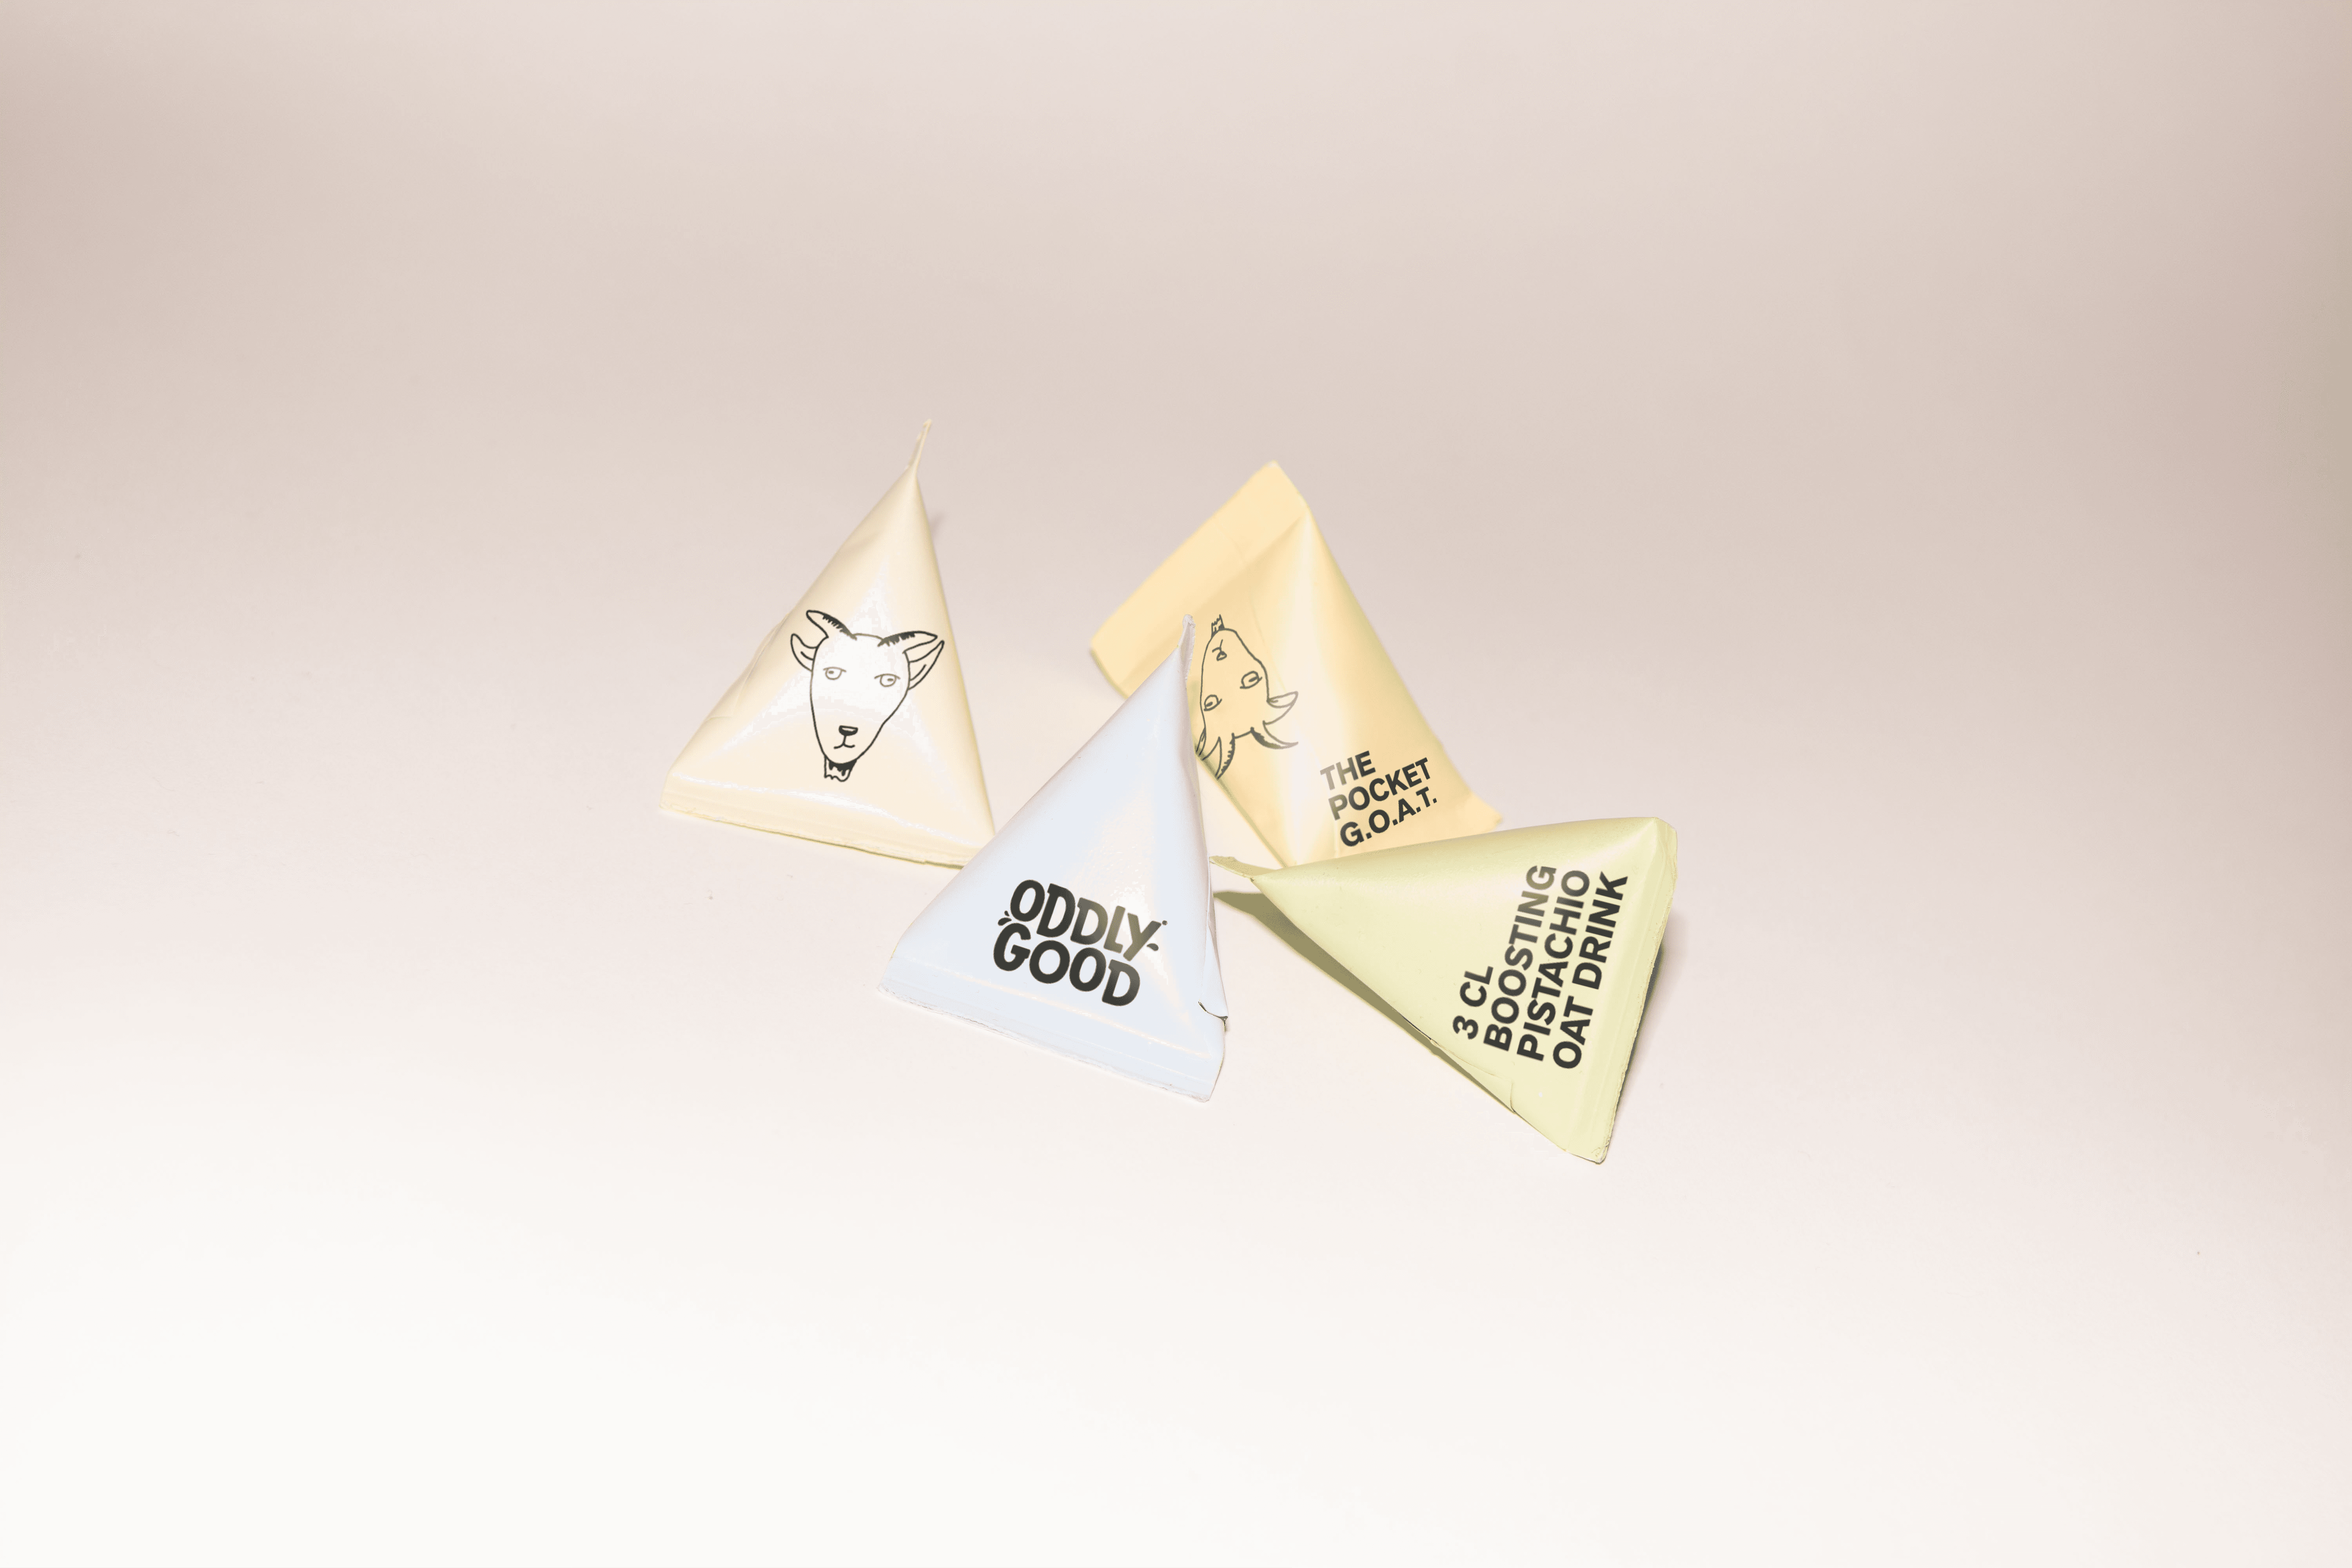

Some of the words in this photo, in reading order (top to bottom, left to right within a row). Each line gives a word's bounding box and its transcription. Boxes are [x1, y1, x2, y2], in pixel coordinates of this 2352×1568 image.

[1320, 751, 1376, 790] THE
[1328, 758, 1430, 820] POCKET
[1340, 787, 1437, 847] G.O.A.T.
[1010, 880, 1161, 961] ODDLY
[1572, 871, 1628, 989] DRINK
[993, 923, 1140, 1006] GOOD
[1460, 966, 1494, 1007] CL
[1483, 865, 1556, 1052] BOOSTING
[1517, 870, 1590, 1061] PISTACHIO
[1452, 1015, 1479, 1039] 3
[1553, 995, 1593, 1069] OAT
